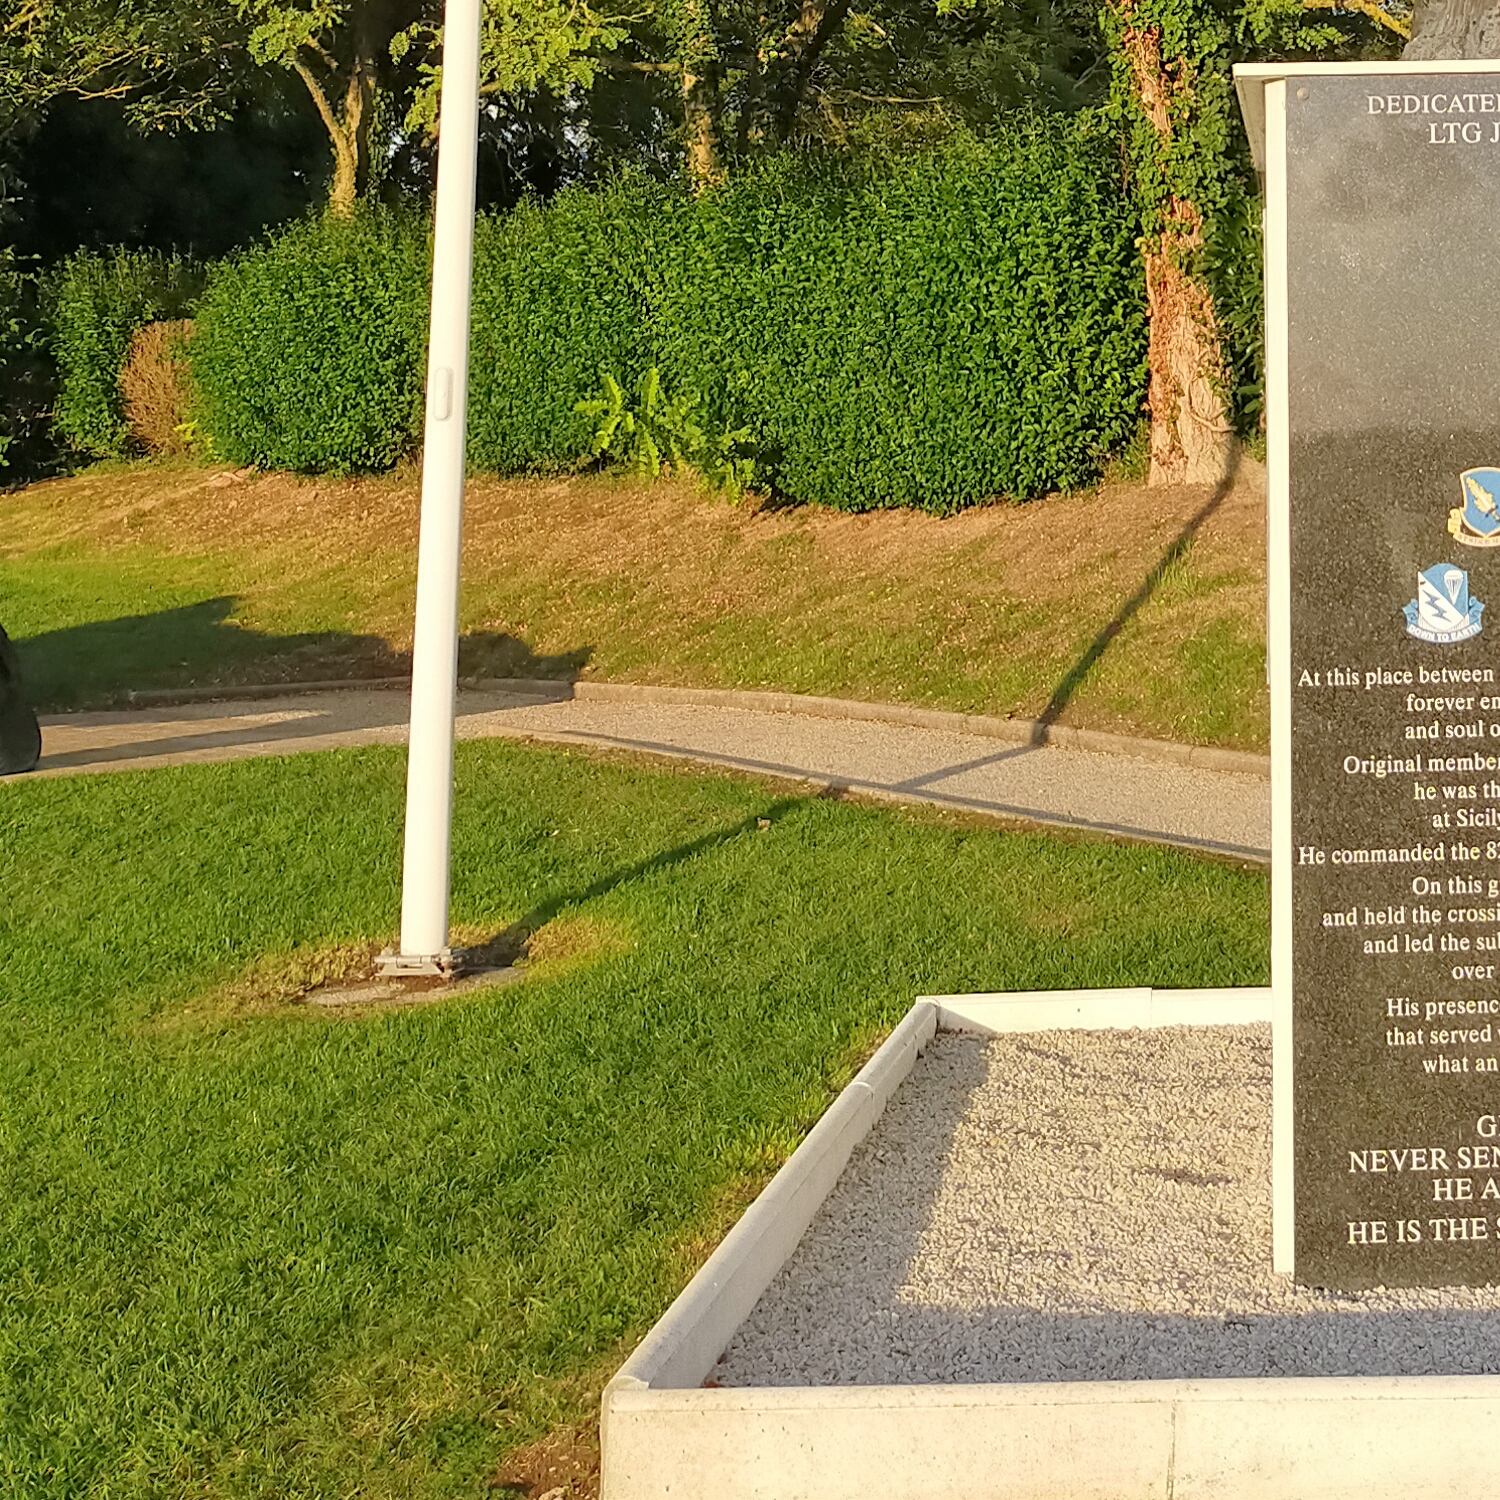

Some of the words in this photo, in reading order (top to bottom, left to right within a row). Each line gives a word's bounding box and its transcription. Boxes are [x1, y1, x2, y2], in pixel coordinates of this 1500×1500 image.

[1429, 122, 1482, 144] LTG
[1407, 624, 1435, 640] DOWN
[1437, 633, 1450, 642] TO
[1450, 623, 1480, 640] EARTH
[1298, 669, 1321, 687] At
[1326, 667, 1360, 687] this
[1365, 666, 1413, 691] place
[1419, 665, 1494, 684] between
[1406, 693, 1475, 712] forever
[1405, 720, 1440, 740] and
[1445, 719, 1484, 739] soul
[1343, 754, 1422, 779] Original
[1413, 781, 1437, 801] he
[1442, 785, 1477, 799] was
[1432, 812, 1451, 828] at
[1299, 846, 1326, 865] He
[1331, 842, 1445, 865] commanded
[1451, 841, 1481, 861] the
[1412, 876, 1442, 896] On
[1447, 875, 1483, 895] this
[1322, 906, 1358, 928] and
[1364, 905, 1406, 926] held
[1412, 905, 1442, 926] the
[1363, 934, 1399, 954] and
[1404, 933, 1434, 953] led
[1440, 932, 1470, 952] the
[1451, 965, 1495, 980] over
[1386, 997, 1420, 1018] His
[1386, 1026, 1424, 1047] that
[1430, 1024, 1492, 1045] served
[1422, 1054, 1469, 1074] what
[1475, 1057, 1499, 1072] an
[1348, 1147, 1449, 1174] NEVER
[1432, 1178, 1473, 1202] HE
[1347, 1221, 1388, 1245] HE
[1396, 1219, 1421, 1243] IS
[1428, 1217, 1489, 1242] THE
